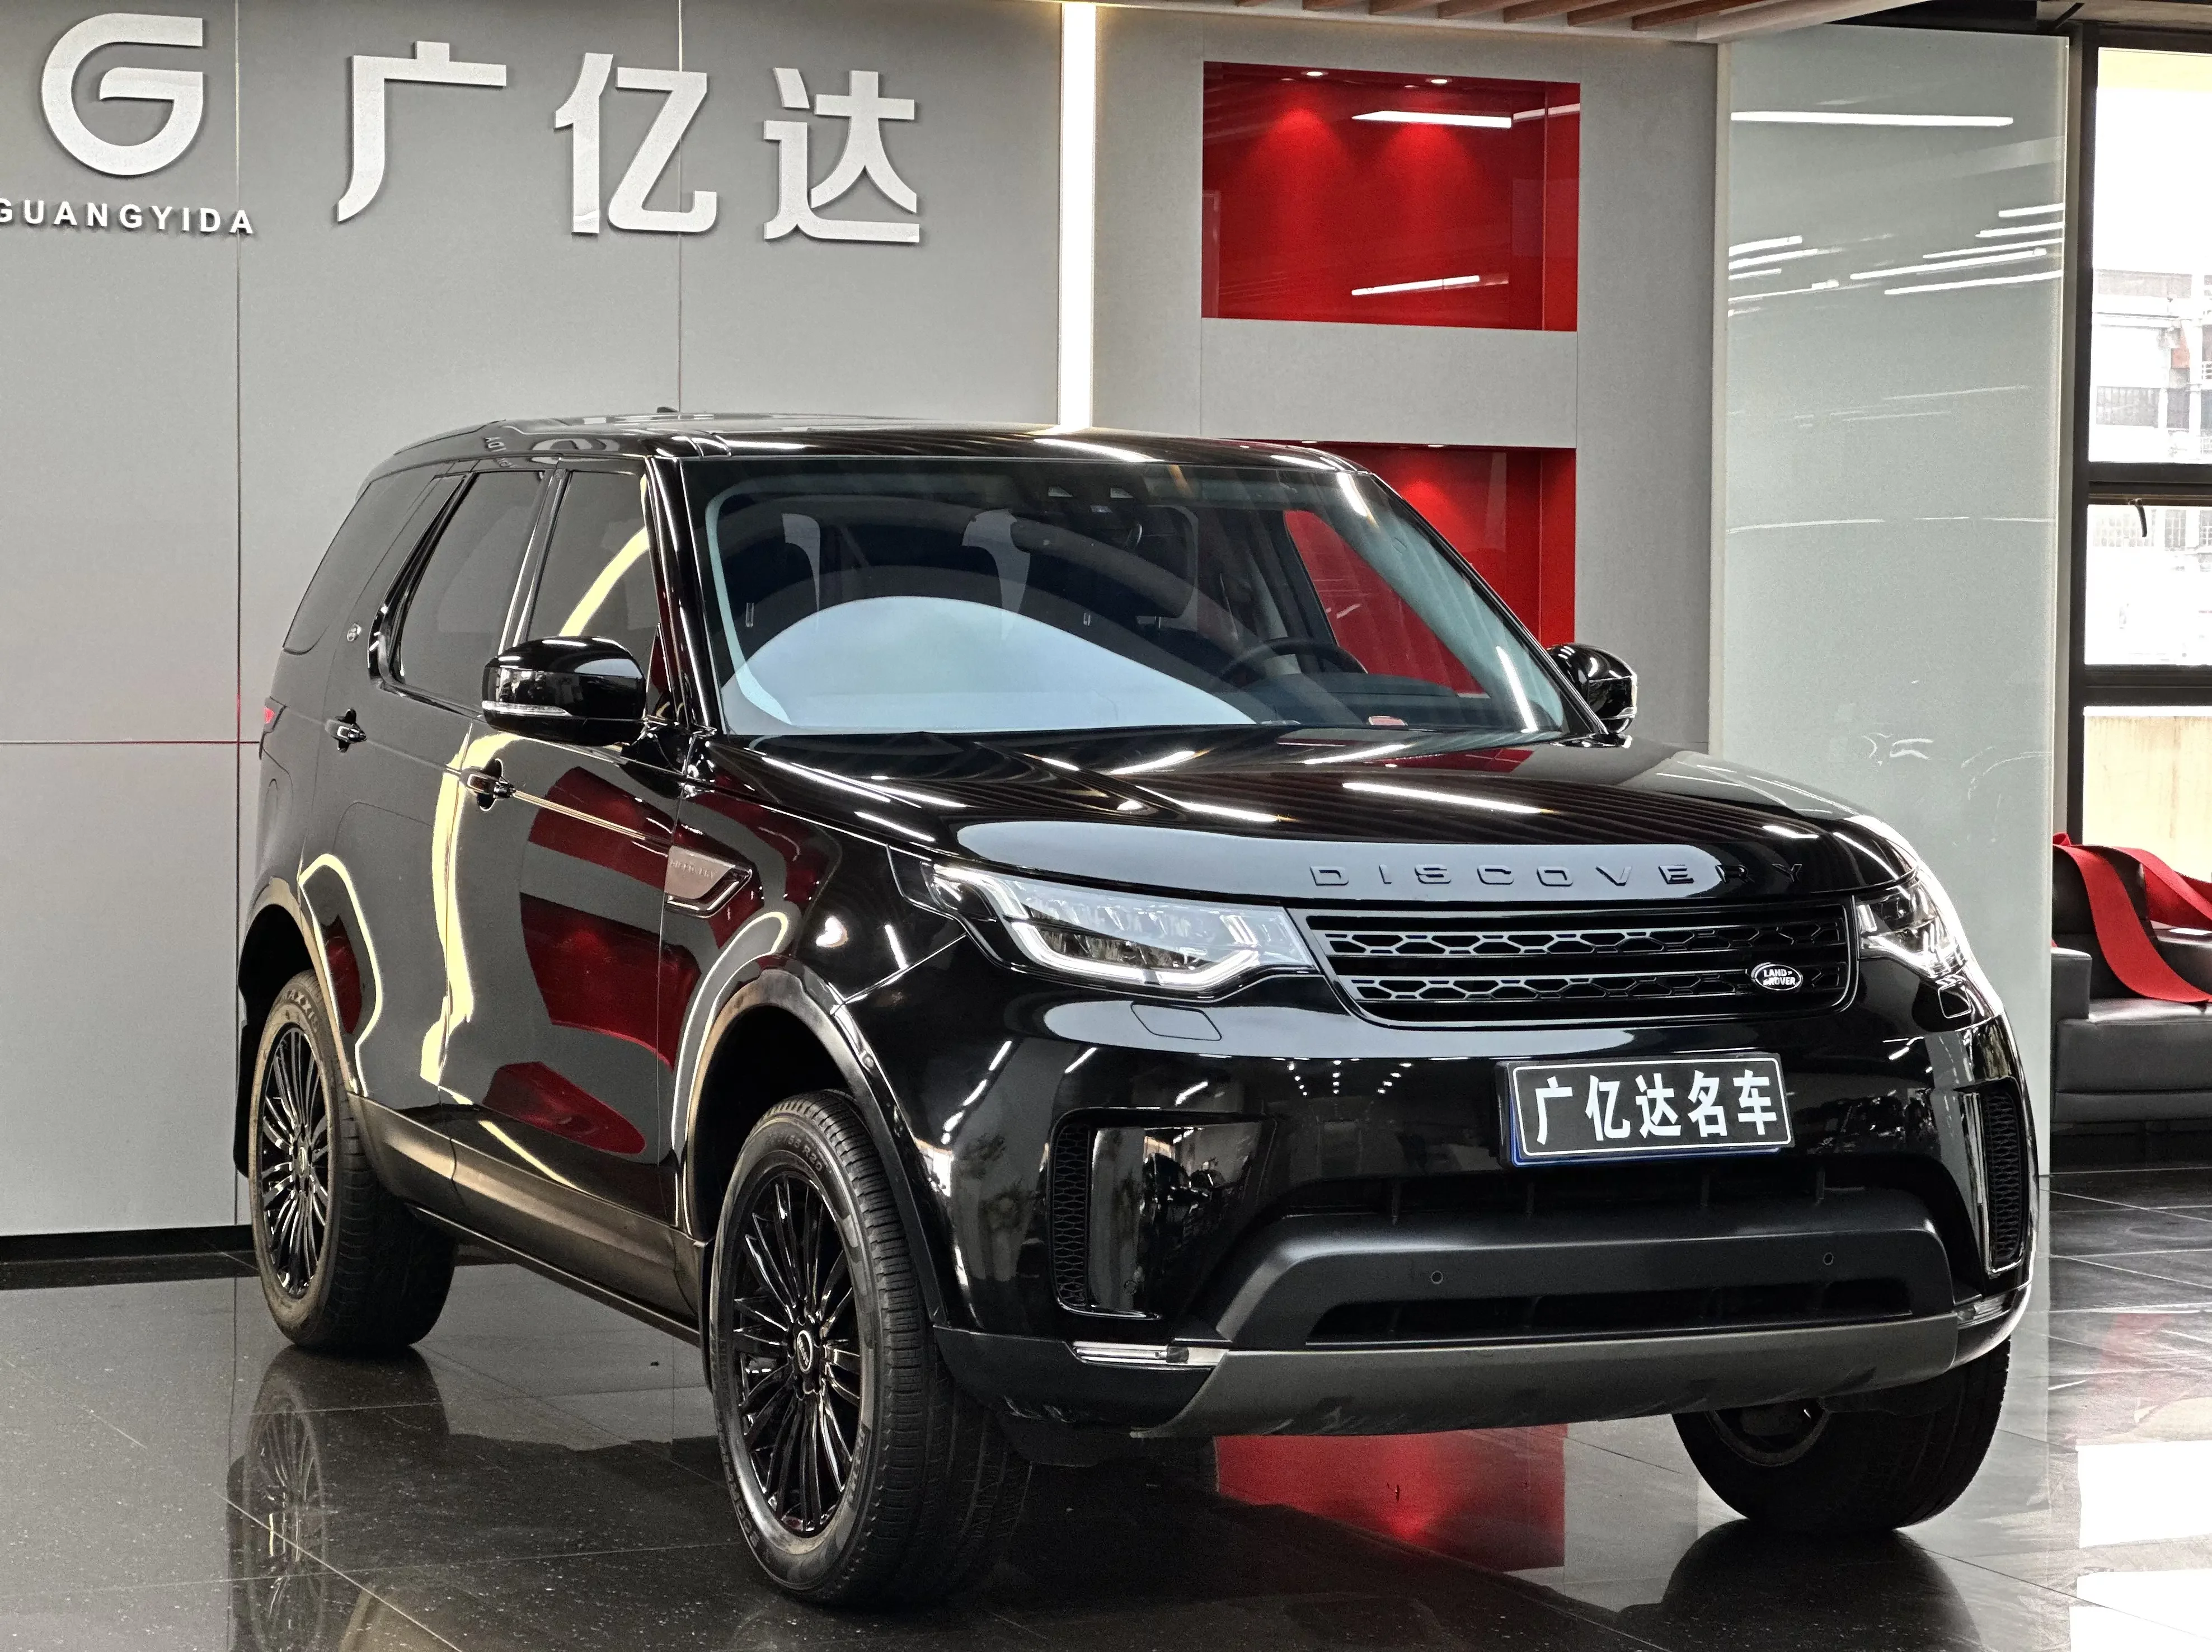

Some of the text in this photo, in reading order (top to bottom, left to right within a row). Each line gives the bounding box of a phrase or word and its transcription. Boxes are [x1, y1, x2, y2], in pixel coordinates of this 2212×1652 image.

[337, 40, 921, 243] 广亿达
[0, 198, 253, 235] GUANGYIDA
[1763, 969, 1787, 978] LAND
[1768, 977, 1796, 985] ROVER
[1534, 1068, 1778, 1146] 广亿达名车
